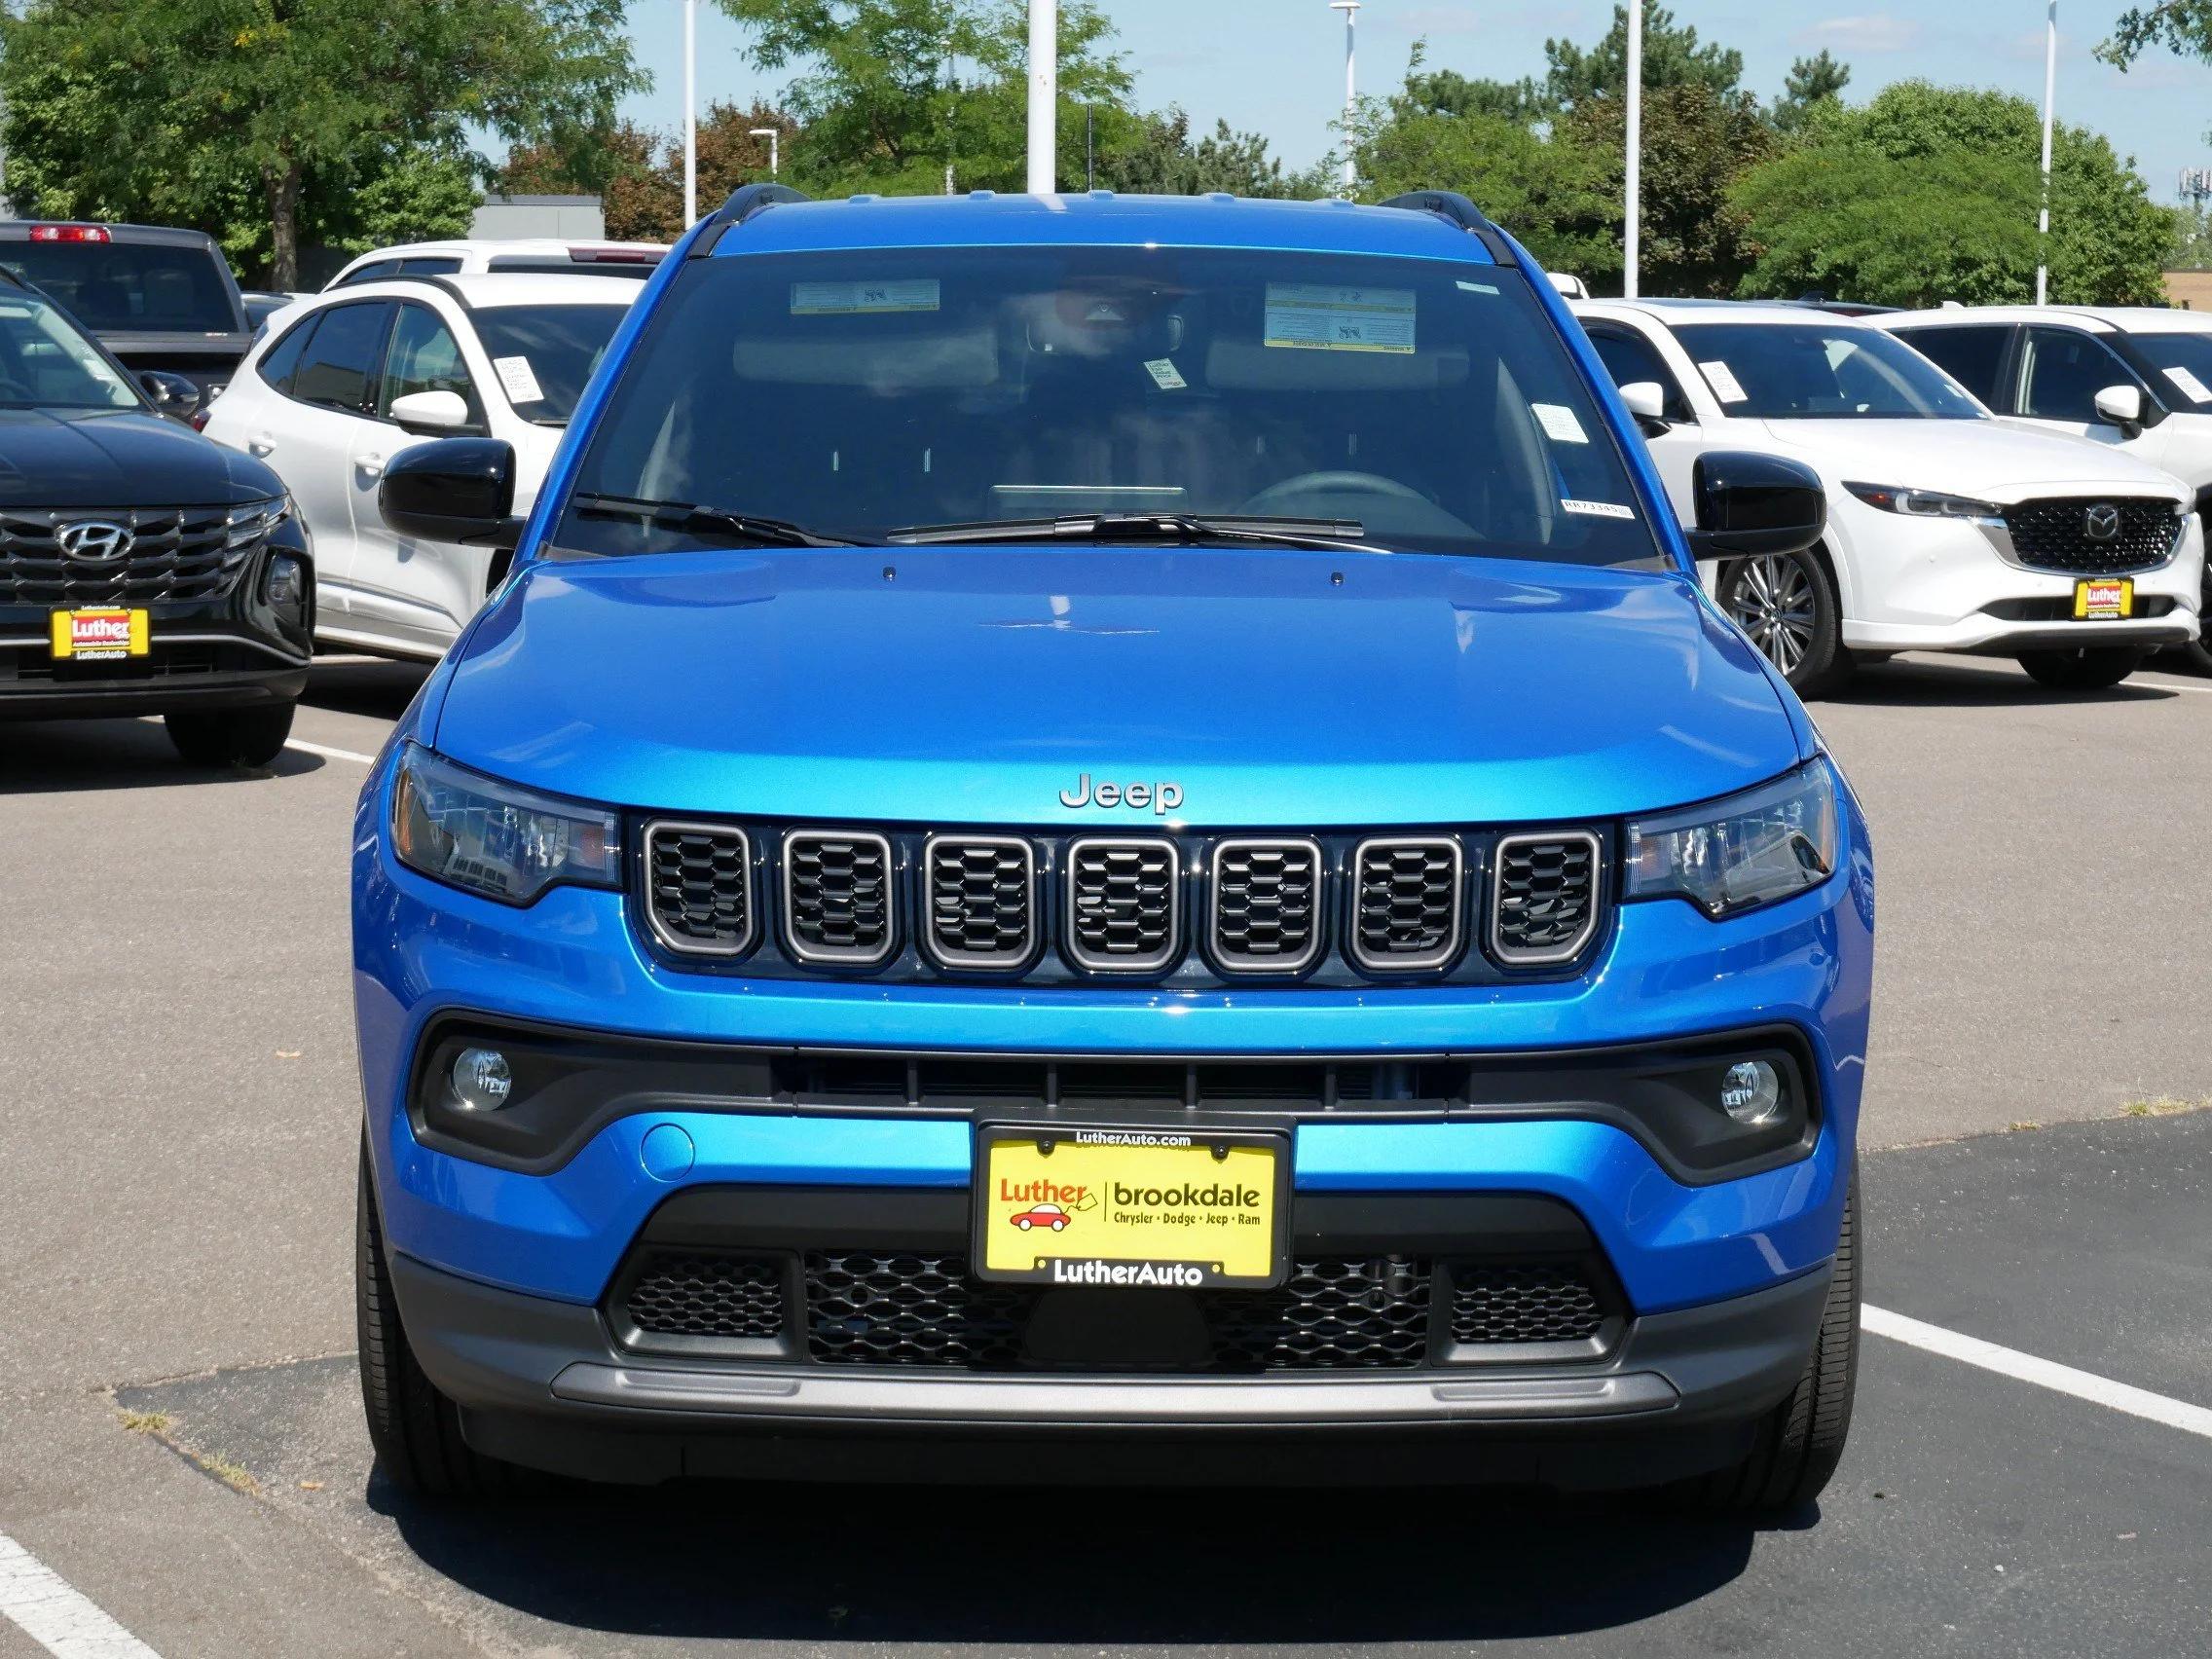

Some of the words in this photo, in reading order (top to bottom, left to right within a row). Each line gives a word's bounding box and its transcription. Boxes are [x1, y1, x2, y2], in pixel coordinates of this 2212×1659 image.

[72, 618, 130, 638] Luther
[76, 649, 128, 660] LutherAuto
[1059, 773, 1184, 816] Jeep
[1075, 1131, 1192, 1147] LutherAuto.com
[1000, 1178, 1088, 1204] Luther
[1114, 1181, 1261, 1208] brookdale
[1113, 1212, 1154, 1226] Chrysler
[1162, 1212, 1197, 1226] Dodge
[1205, 1213, 1229, 1227] Jeep
[1237, 1213, 1261, 1226] Ram
[1053, 1259, 1203, 1287] LutherAuto
